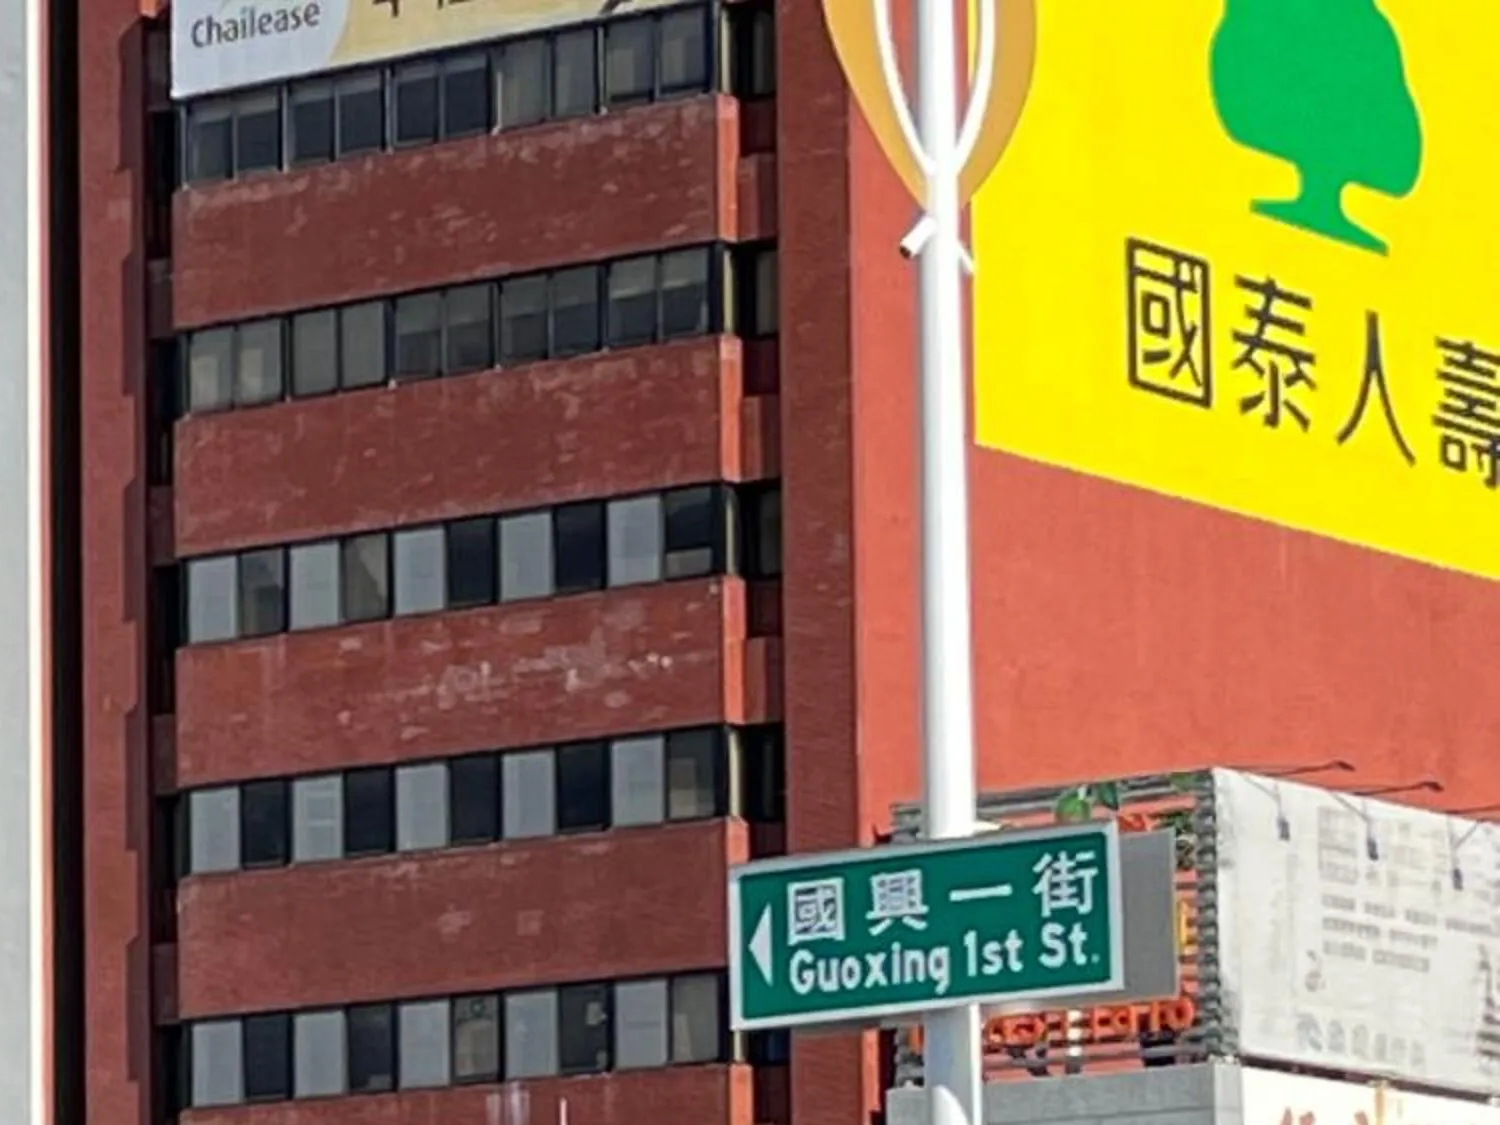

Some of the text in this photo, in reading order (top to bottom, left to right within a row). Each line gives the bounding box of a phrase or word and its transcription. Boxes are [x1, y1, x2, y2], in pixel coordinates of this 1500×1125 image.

[191, 1, 320, 48] Chailease
[1125, 235, 1500, 490] 國泰人壽
[786, 849, 1099, 947] 國興一街
[788, 921, 1100, 995] Guoxing 1st St.
